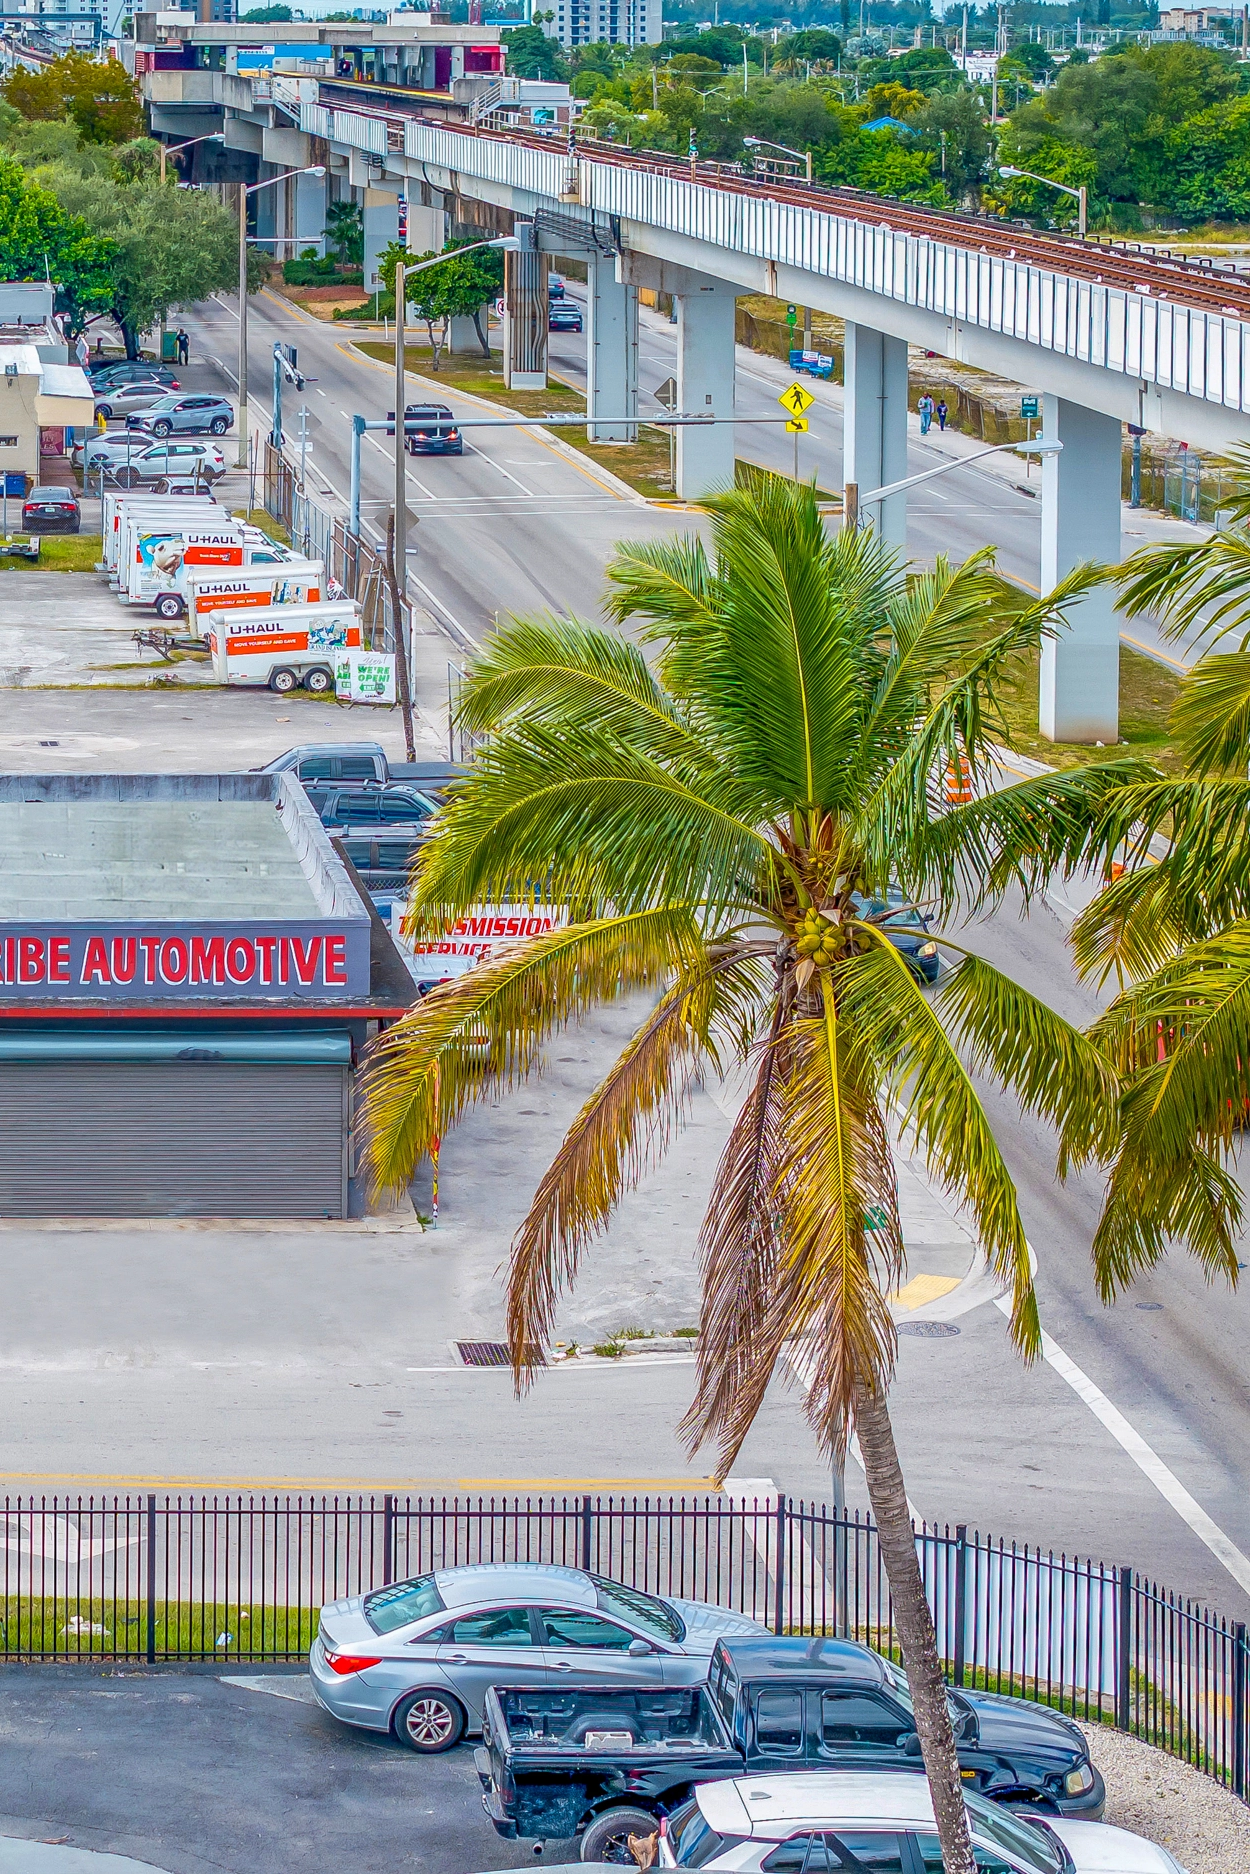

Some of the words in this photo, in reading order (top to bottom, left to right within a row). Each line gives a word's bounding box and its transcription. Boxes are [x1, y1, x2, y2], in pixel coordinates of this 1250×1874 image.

[188, 535, 237, 545] U-HAUL
[199, 583, 251, 594] U-HAUL
[230, 623, 284, 635] U-HAUL
[357, 665, 391, 674] WE'RE
[357, 674, 391, 683] OPEN!
[79, 935, 348, 987] AUTOMOTIVE
